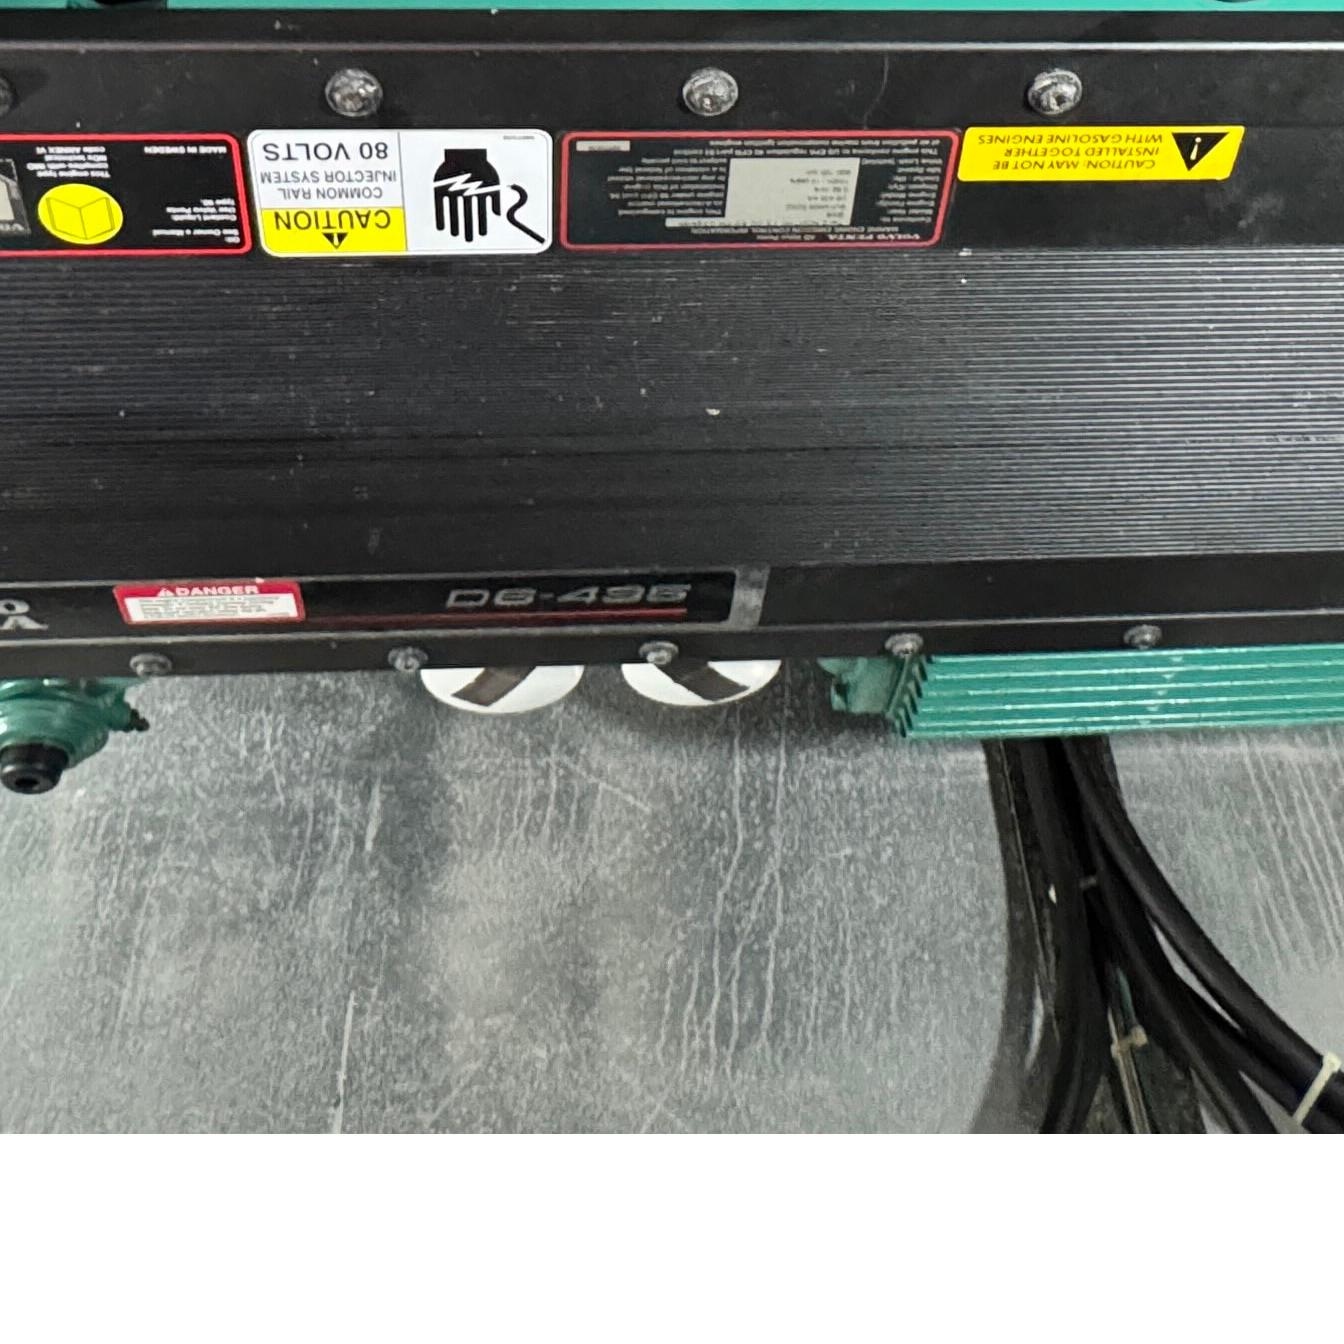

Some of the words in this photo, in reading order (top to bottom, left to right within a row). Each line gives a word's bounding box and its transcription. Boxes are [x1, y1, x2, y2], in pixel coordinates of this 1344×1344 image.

[978, 135, 1043, 145] ENGINES
[1045, 134, 1122, 144] GASOLINE
[1125, 134, 1163, 144] WITH
[144, 146, 186, 154] SWEDEN
[199, 146, 227, 154] MADE
[262, 143, 350, 161] VOLTS
[359, 142, 388, 160] 80
[1004, 148, 1081, 158] TOGETHER
[1084, 147, 1160, 157] INSTALLED
[993, 161, 1009, 170] BE
[1012, 160, 1045, 170] NOT
[1048, 160, 1079, 169] MAY
[260, 171, 320, 183] SYSTEM
[321, 169, 397, 182] INJECTOR
[277, 187, 311, 200] RAIL
[315, 186, 383, 200] COMMON
[273, 208, 391, 230] CAUTION
[175, 585, 259, 596] DANGER
